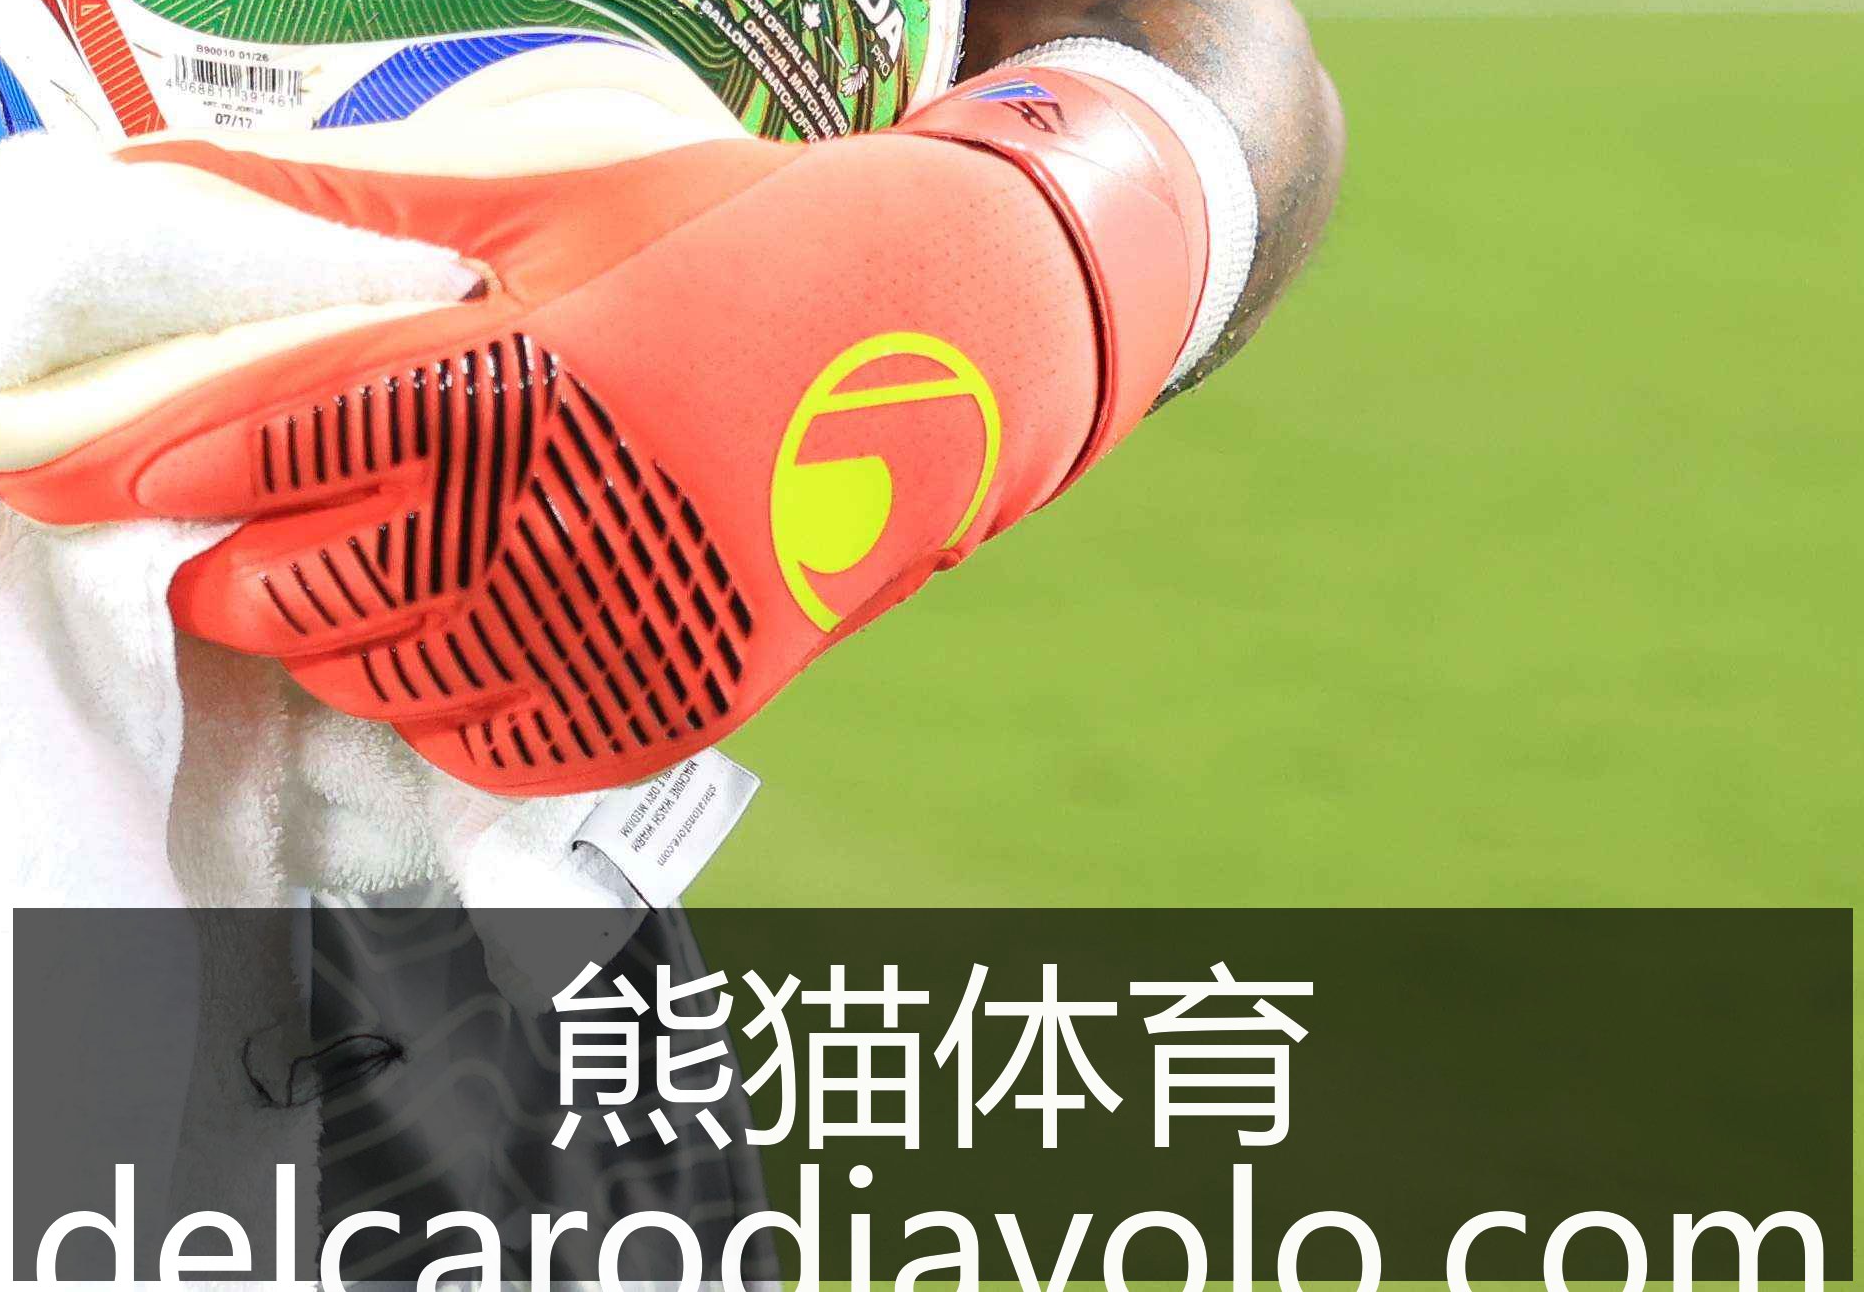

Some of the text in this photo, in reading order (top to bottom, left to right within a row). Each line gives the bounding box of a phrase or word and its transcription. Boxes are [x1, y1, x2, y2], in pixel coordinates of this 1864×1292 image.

[699, 0, 753, 55] BALLON
[747, 50, 767, 72] DE
[762, 65, 800, 113] MATCH
[743, 19, 791, 78] OFFICIAL
[787, 73, 824, 121] MATCH
[763, 16, 803, 66] OFICIAL
[800, 60, 819, 88] DEL
[816, 85, 849, 136] PARTIDO
[871, 44, 891, 77] PRO
[215, 113, 253, 129] 07/17
[619, 802, 650, 838] MEDIUM
[630, 758, 700, 853] MACHINE WASH WARM
[645, 785, 661, 807] DRY
[656, 782, 718, 867] sheratonstore.com
